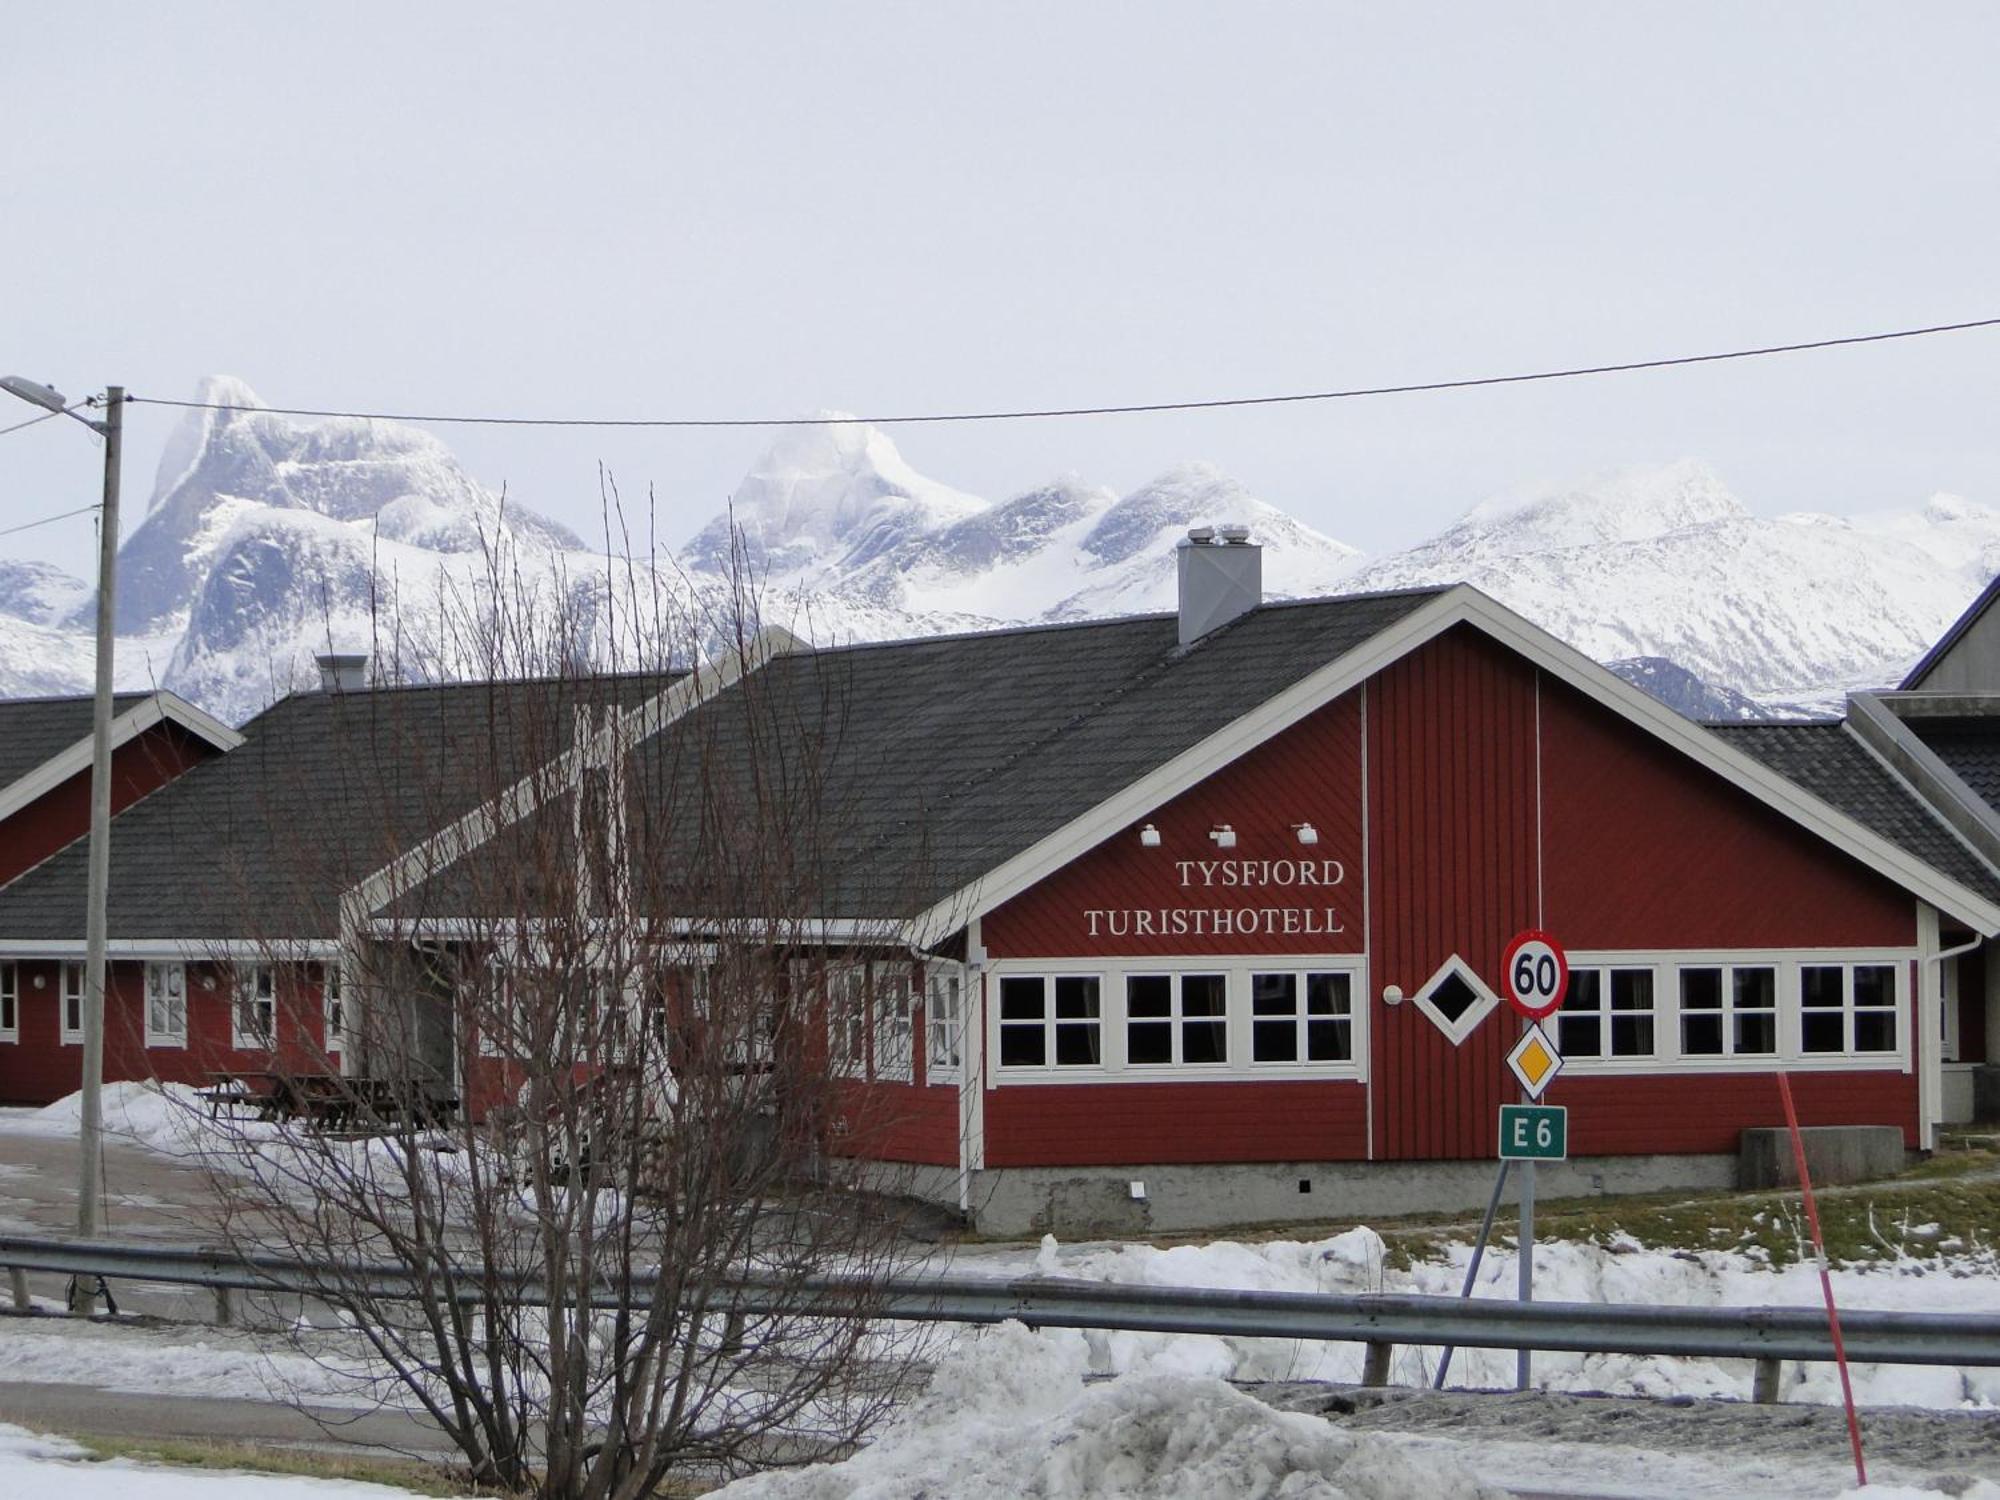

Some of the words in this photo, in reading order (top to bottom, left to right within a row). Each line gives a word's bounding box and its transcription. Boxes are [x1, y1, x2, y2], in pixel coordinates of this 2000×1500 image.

[1175, 860, 1345, 887] TYSFJORD
[1083, 907, 1345, 936] TURISTHOTELL
[1514, 953, 1556, 996] 60
[1514, 1118, 1528, 1147] E
[1536, 1118, 1552, 1147] 6
